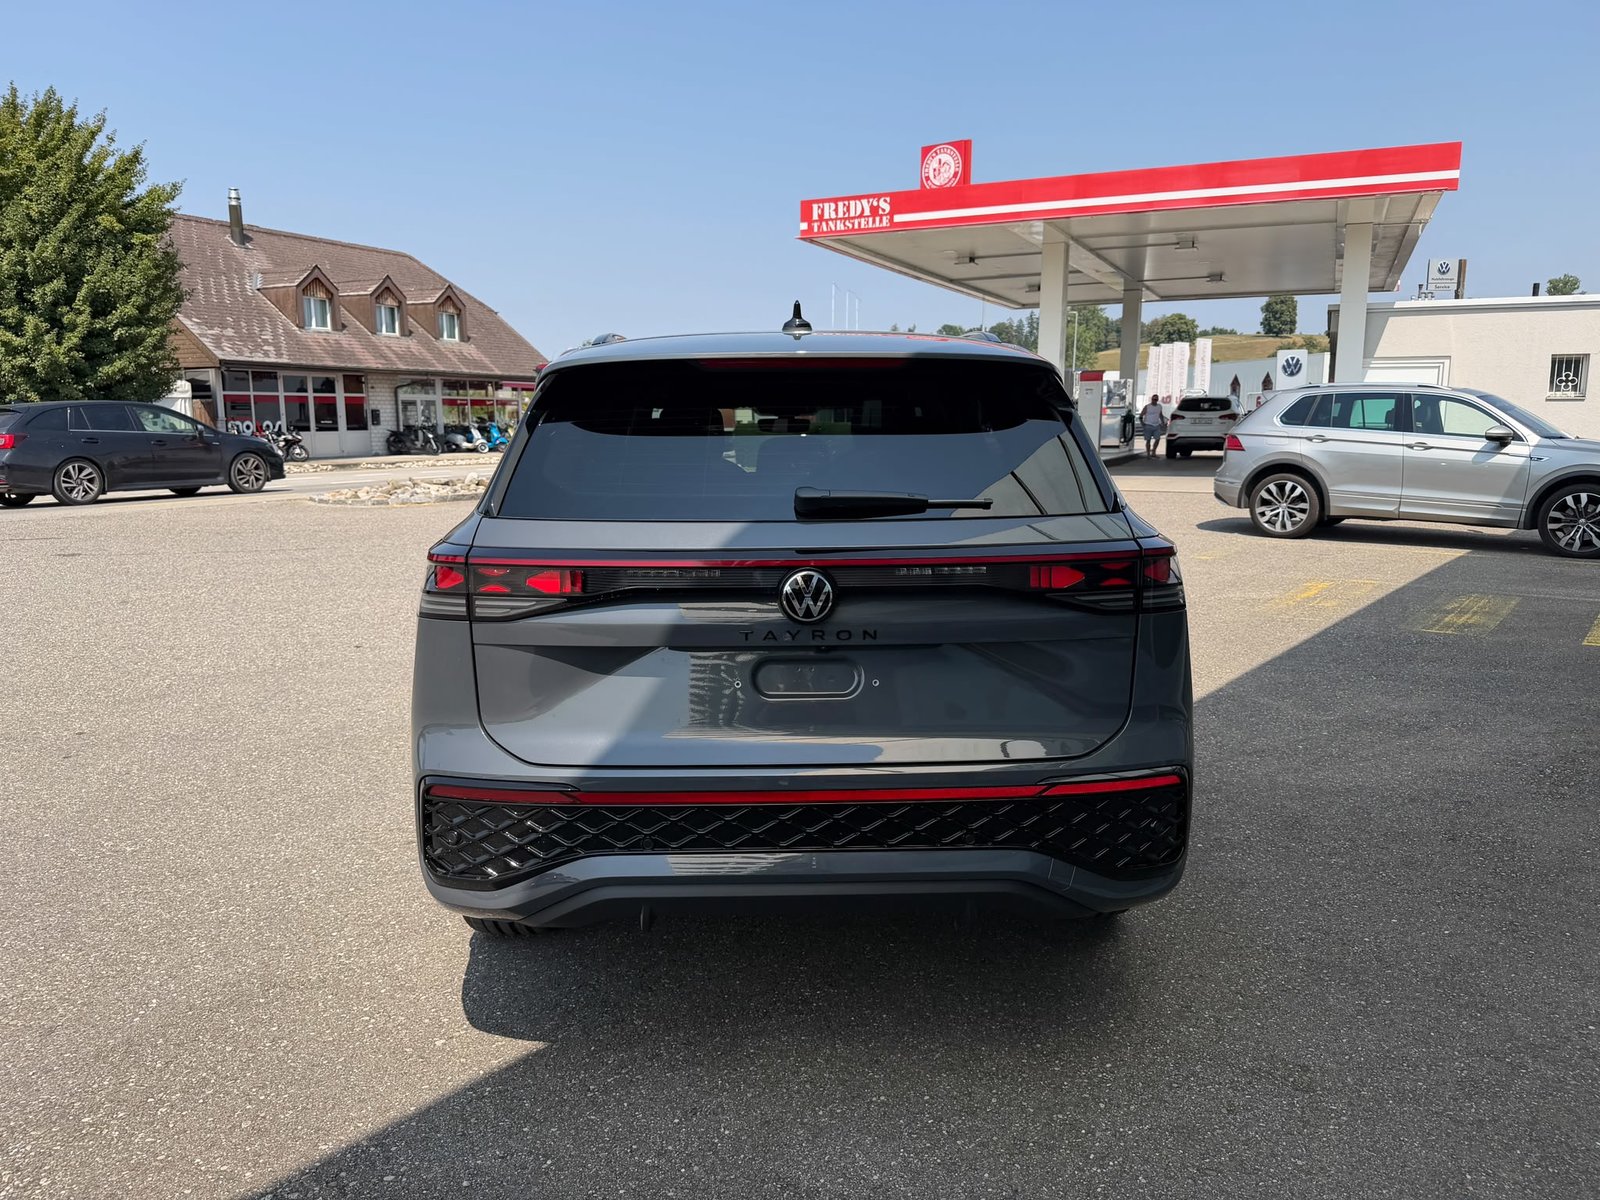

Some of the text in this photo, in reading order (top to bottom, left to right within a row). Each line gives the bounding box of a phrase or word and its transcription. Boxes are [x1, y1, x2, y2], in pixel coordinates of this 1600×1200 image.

[811, 197, 891, 221] FREDY'S
[811, 215, 891, 233] TANKSTELLE
[739, 629, 878, 642] TAYRON
